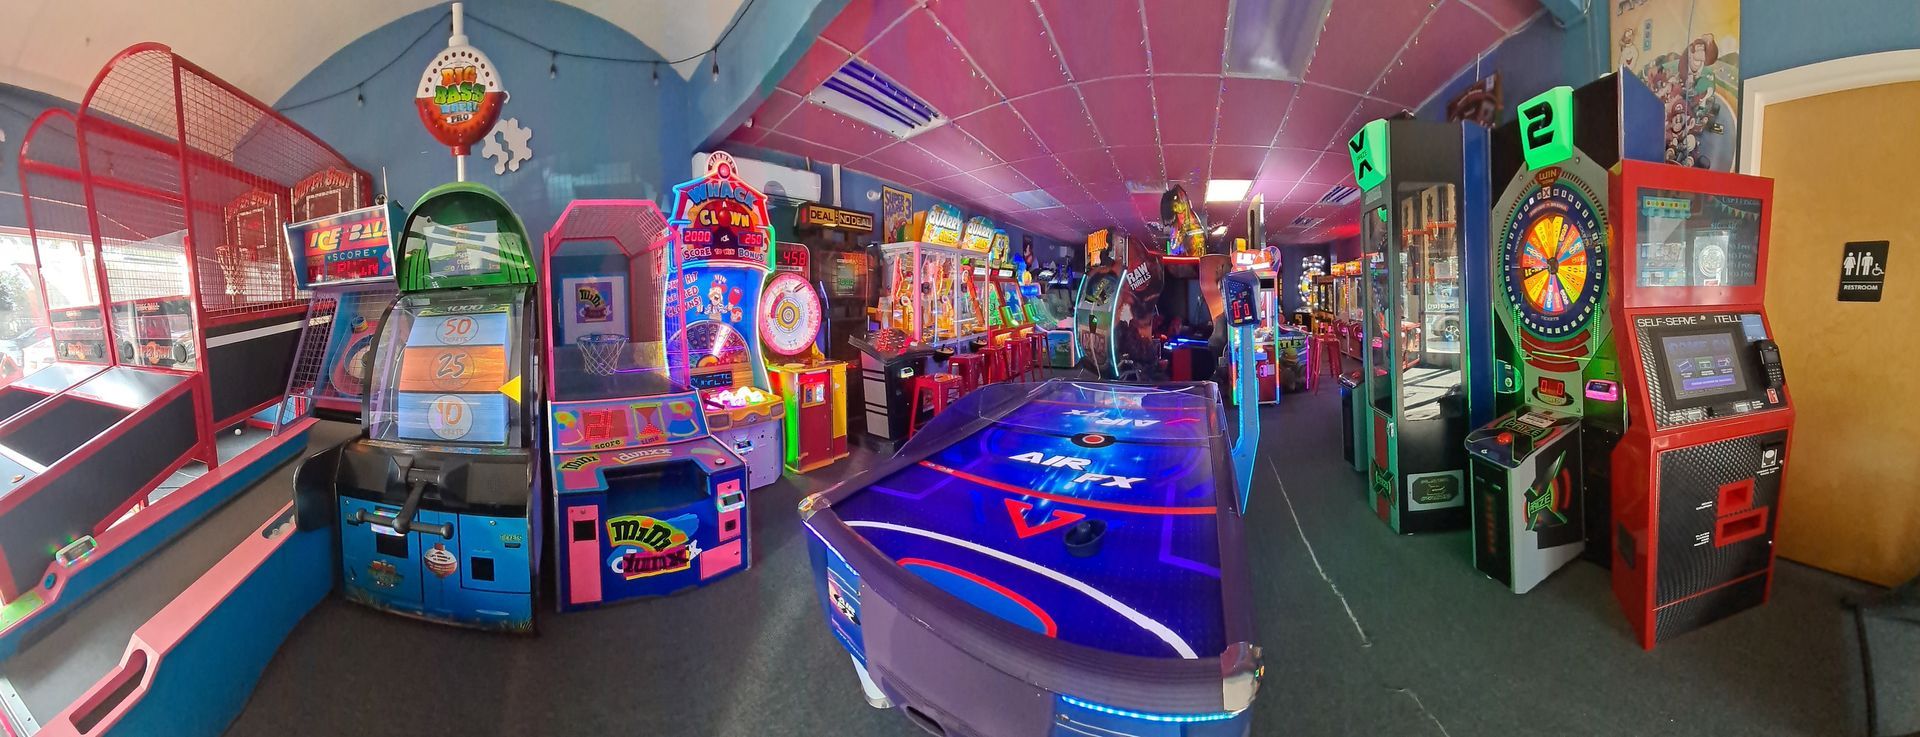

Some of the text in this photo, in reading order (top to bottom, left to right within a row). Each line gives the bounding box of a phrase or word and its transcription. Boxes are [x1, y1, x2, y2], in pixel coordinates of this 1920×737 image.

[441, 66, 477, 86] BIG
[434, 82, 486, 104] BASS
[451, 114, 469, 123] PRO
[1539, 168, 1557, 180] WIN
[687, 181, 758, 210] WHACK
[810, 210, 834, 222] DEAL
[840, 214, 851, 224] NO
[851, 217, 872, 227] DEAL
[929, 209, 962, 231] QUARRY
[310, 227, 342, 251] ICE
[685, 231, 711, 242] 2000
[745, 233, 762, 245] 250
[967, 224, 993, 239] QUARRY
[332, 249, 369, 261] SCORE
[683, 246, 712, 259] SCORE
[737, 247, 764, 260] BONUS
[783, 251, 806, 266] 458
[685, 272, 698, 284] HIT
[1126, 262, 1149, 284] RAW
[1131, 272, 1152, 290] THRILLS
[445, 319, 472, 336] 50
[1637, 316, 1697, 328] SELF-SERVE
[436, 353, 467, 378] 25
[1504, 419, 1542, 437] PRIZE
[595, 439, 620, 449] score
[1008, 451, 1092, 471] AIR
[1073, 473, 1147, 489] FX
